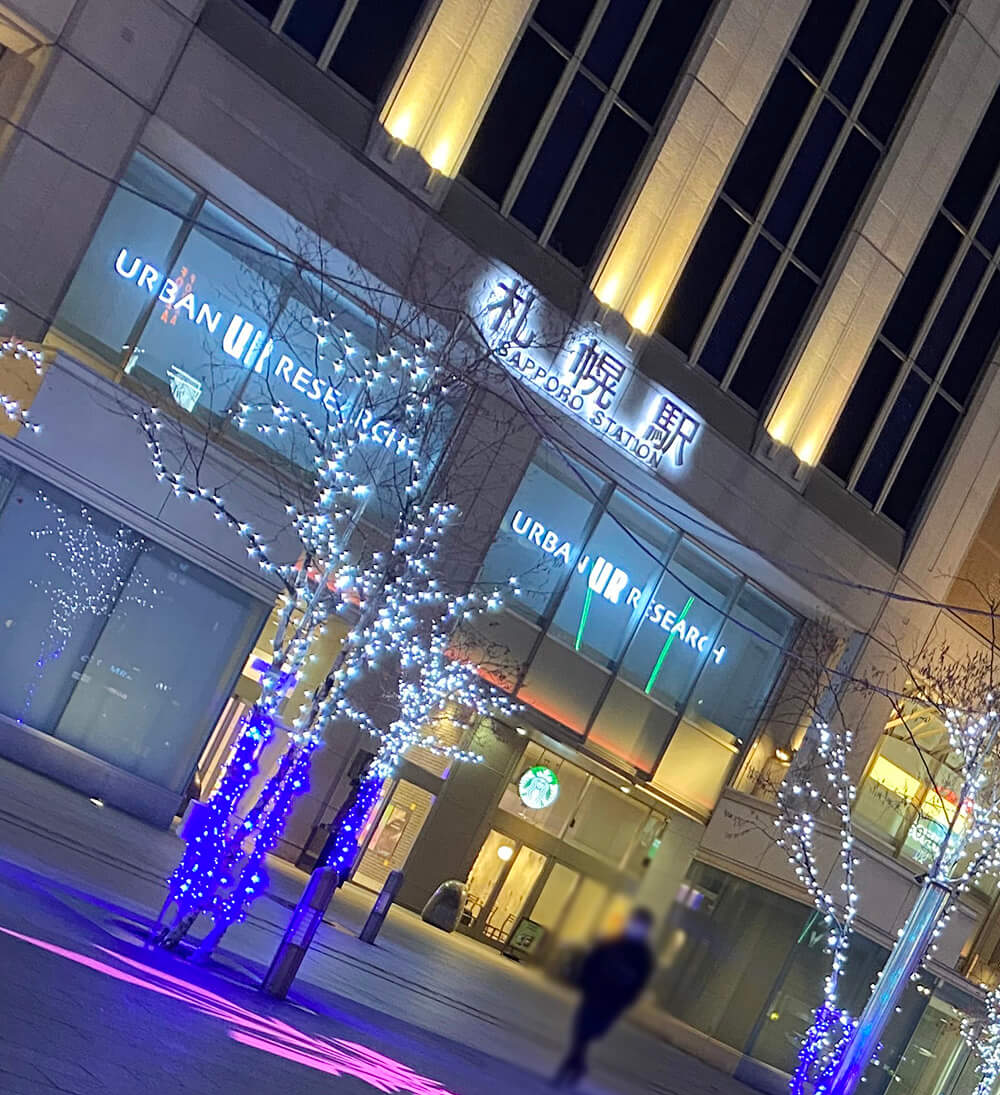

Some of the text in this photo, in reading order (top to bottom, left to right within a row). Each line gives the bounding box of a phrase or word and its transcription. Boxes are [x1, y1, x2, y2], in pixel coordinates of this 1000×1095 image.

[114, 248, 222, 334] URBAN
[487, 278, 700, 467] 札幌駅
[497, 341, 663, 469] SAPPORO STATION
[588, 556, 629, 605] UR
